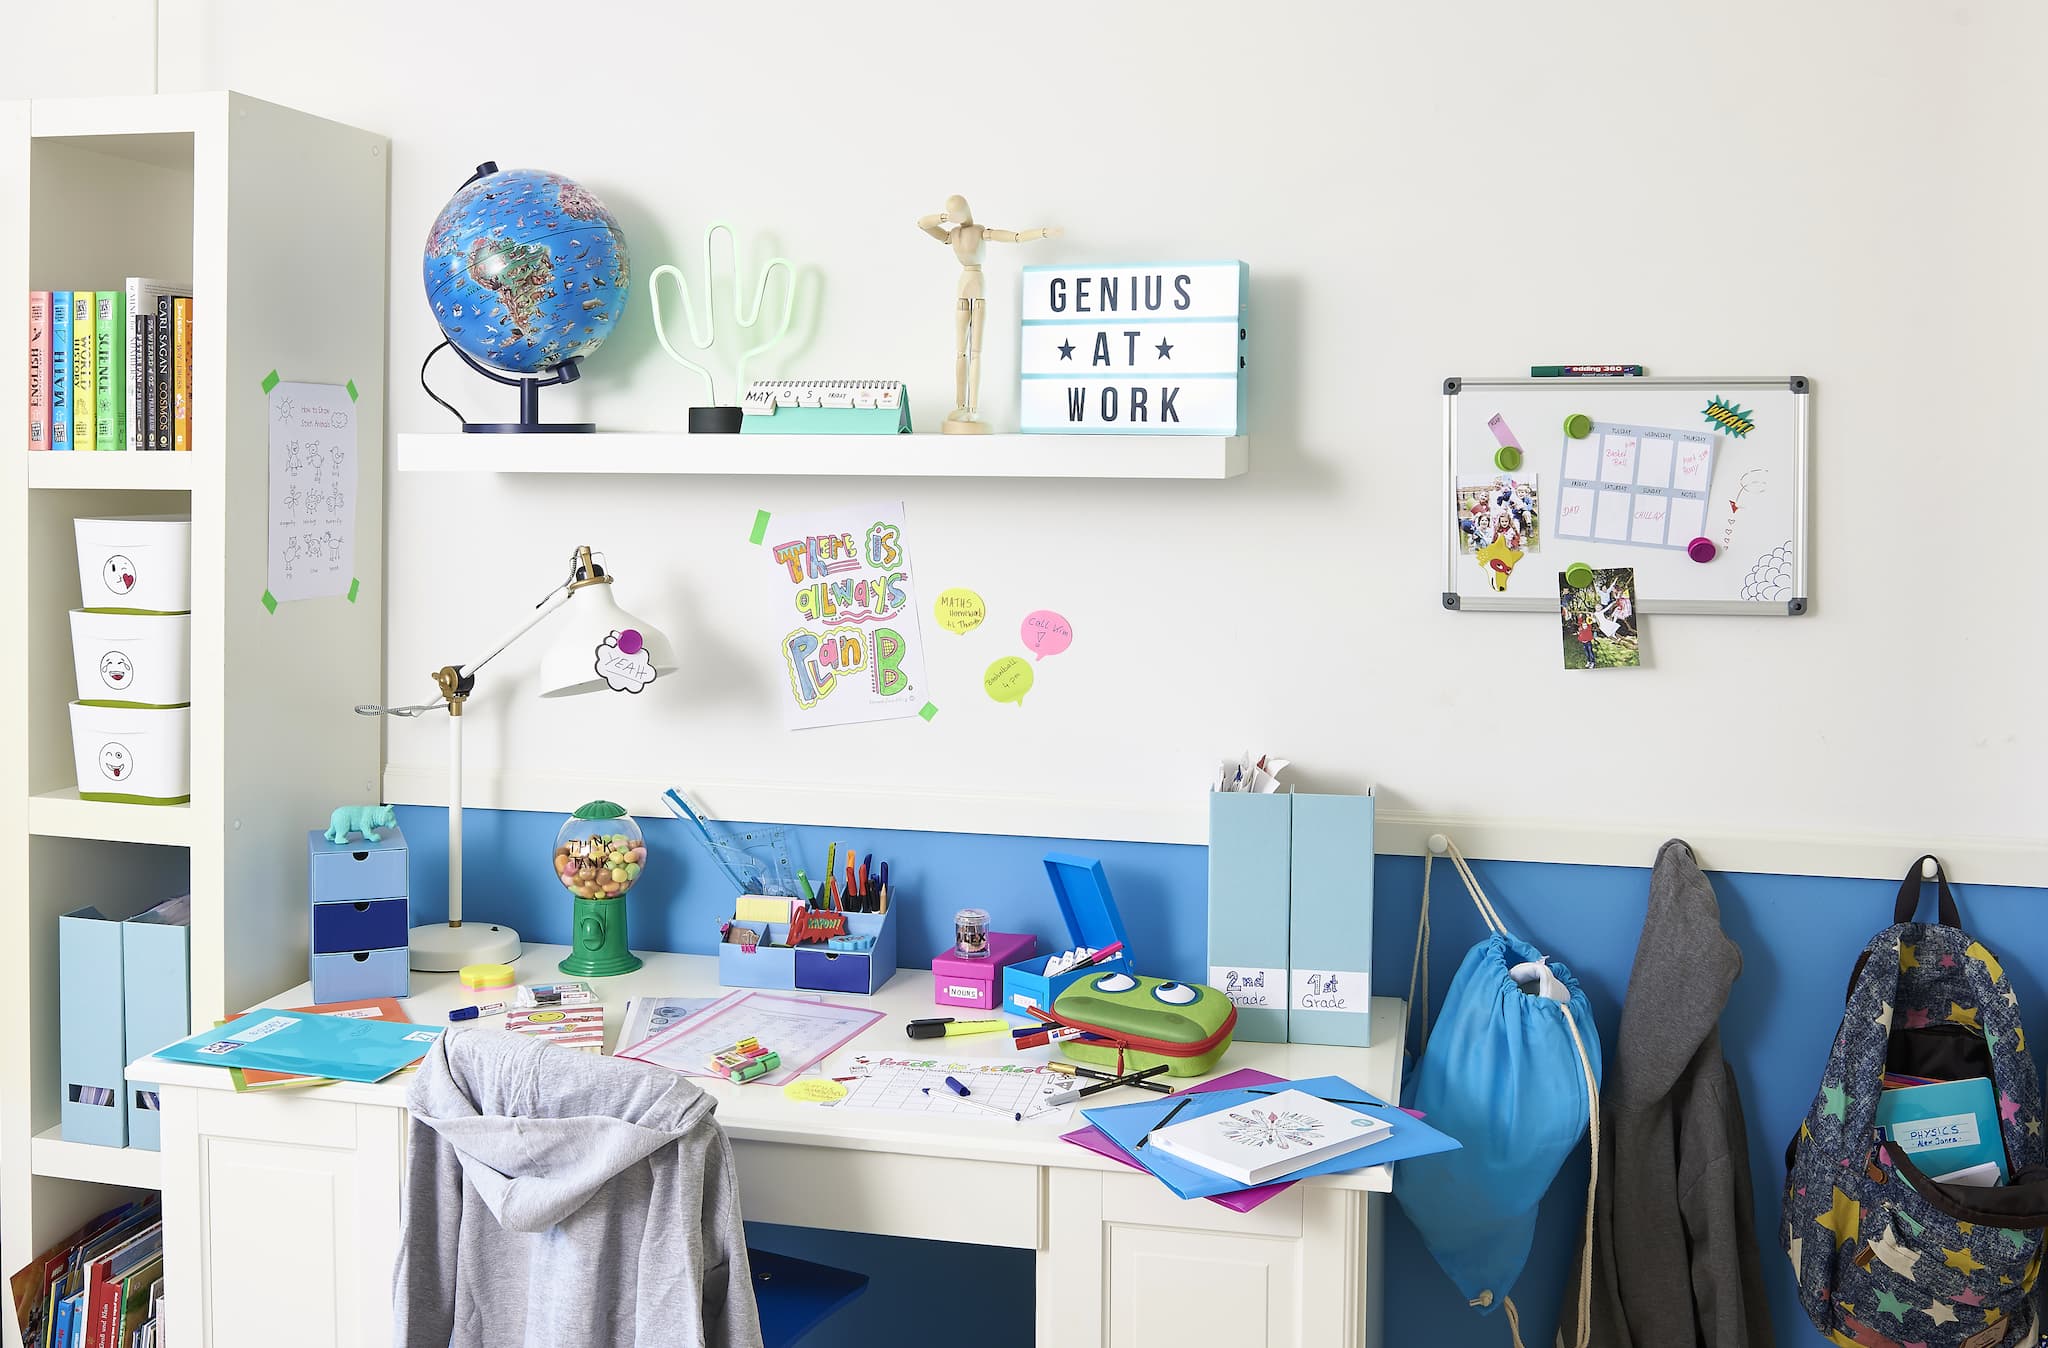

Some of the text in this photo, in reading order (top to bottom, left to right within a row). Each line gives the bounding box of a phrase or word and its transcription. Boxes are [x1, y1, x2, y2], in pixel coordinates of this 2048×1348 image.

[1050, 274, 1191, 312] GENIUS
[1092, 331, 1141, 366] AT
[98, 333, 110, 395] SCIENCE
[159, 300, 168, 430] CARL SAGAN COSMOS
[31, 348, 39, 407] ENGLISH
[53, 351, 65, 407] MATH
[745, 390, 773, 404] MAY
[1068, 387, 1180, 422] WORK
[1705, 403, 1755, 435] WHAM!
[1612, 428, 1631, 436] TUESDAY
[1644, 431, 1671, 440] WEDNESDAY
[1683, 434, 1706, 442] THURSDAY
[1604, 483, 1627, 491] SATURDAY
[941, 597, 973, 608] MATHS
[1028, 618, 1051, 629] Call
[605, 652, 647, 680] YEAH
[575, 856, 609, 869] TANK
[808, 917, 841, 930] KAPOW!
[956, 932, 986, 943] ALEX
[1226, 971, 1264, 991] 2nd
[1307, 974, 1338, 995] 1st
[951, 988, 976, 998] NOUNS
[1302, 993, 1347, 1010] Grade
[1910, 1125, 1960, 1140] PHYSICS
